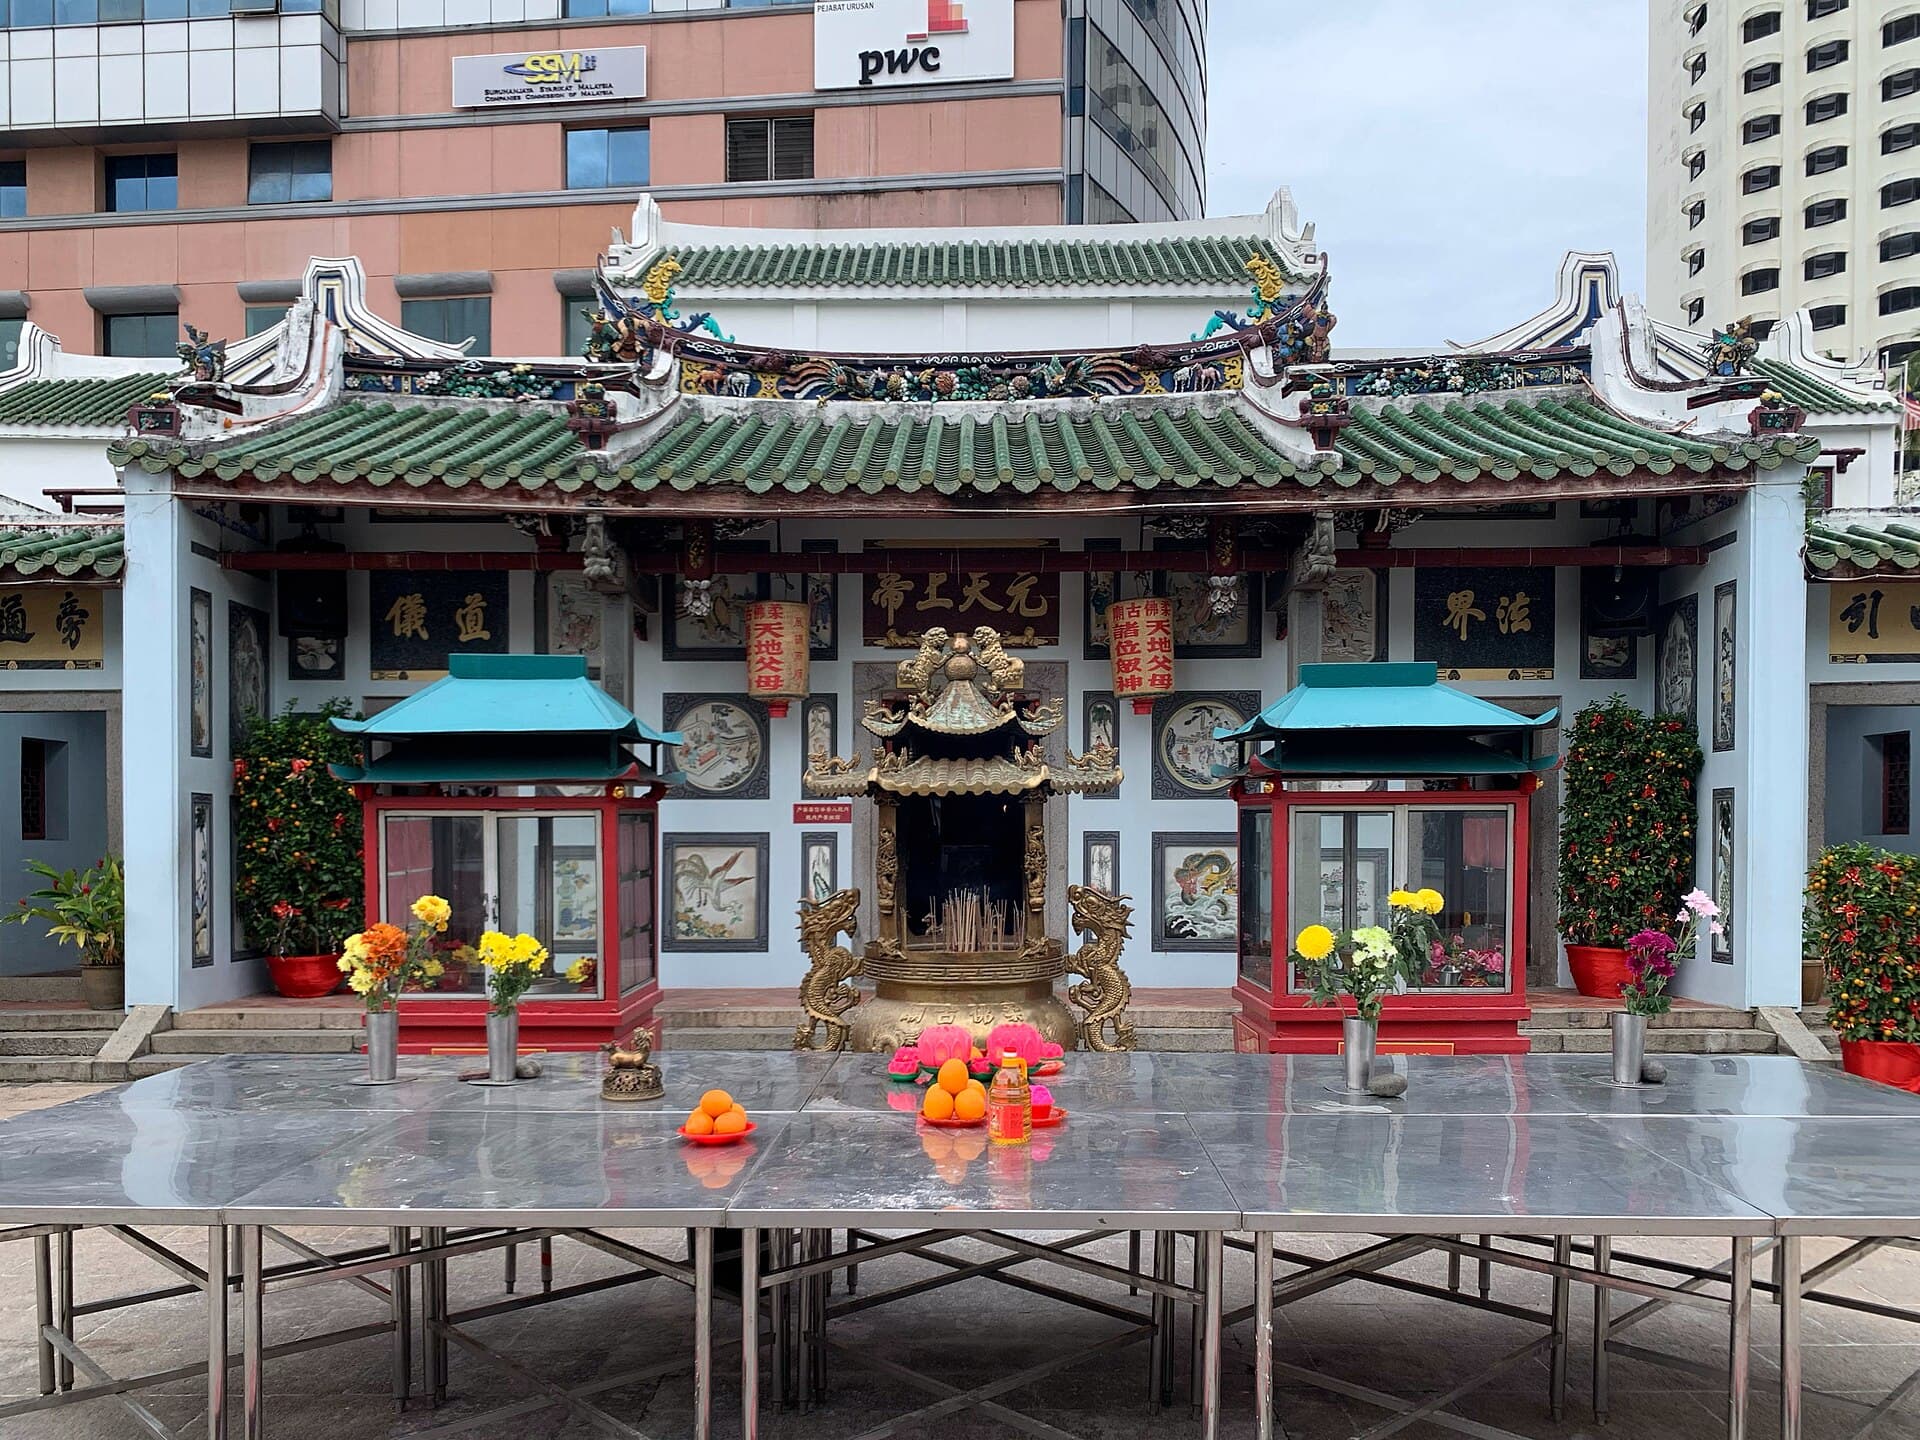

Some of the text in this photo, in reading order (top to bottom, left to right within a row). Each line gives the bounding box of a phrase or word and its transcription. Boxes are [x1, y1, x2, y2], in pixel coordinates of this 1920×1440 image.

[817, 2, 874, 12] PEJABAT URUSAN
[524, 53, 583, 84] SSM
[858, 46, 941, 85] pwc
[754, 622, 785, 690] 天地父母
[1145, 619, 1173, 690] 天地父母
